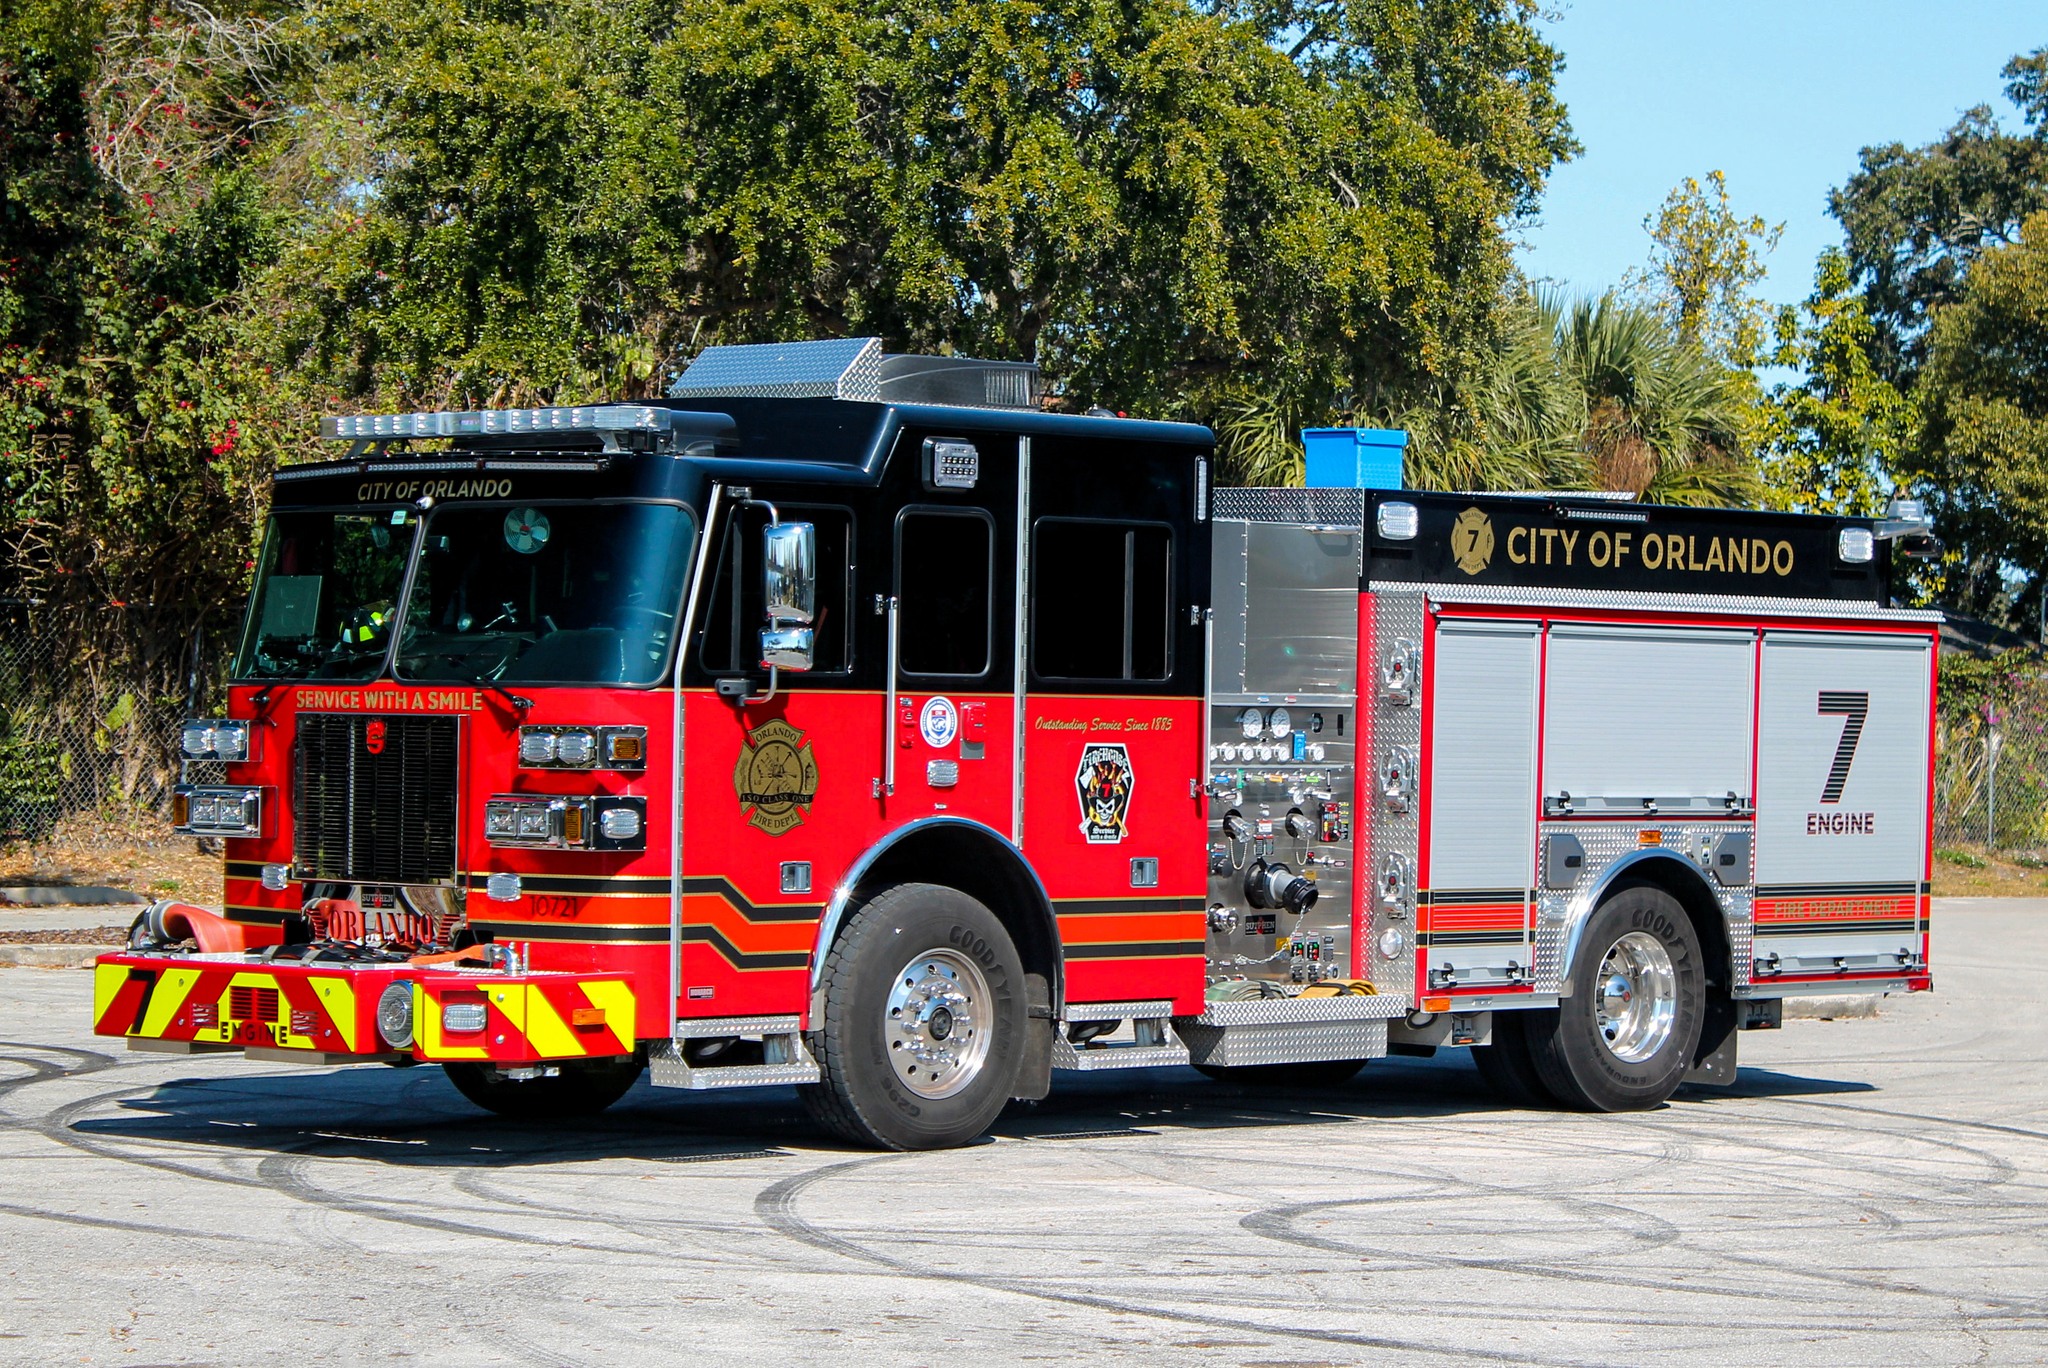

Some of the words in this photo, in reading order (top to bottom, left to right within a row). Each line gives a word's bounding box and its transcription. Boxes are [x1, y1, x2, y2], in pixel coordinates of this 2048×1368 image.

[358, 483, 393, 501] CITY
[395, 481, 420, 499] OF
[423, 478, 512, 498] ORLANDO
[1468, 530, 1479, 552] 7
[1507, 526, 1580, 565] CITY
[1588, 531, 1632, 568] OF
[1641, 533, 1794, 576] ORLANDO
[296, 690, 360, 709] SERVICE
[364, 691, 407, 710] WITH
[411, 692, 424, 710] A
[428, 692, 483, 711] SMILE
[755, 727, 797, 743] ORLANDO
[1035, 716, 1088, 734] Outstanding
[1090, 717, 1122, 731] Service
[1124, 718, 1149, 732] Since
[1151, 717, 1173, 731] 1885
[1818, 690, 1869, 804] 7
[762, 793, 789, 803] CLASS
[1102, 783, 1111, 798] 7
[755, 812, 772, 828] FIRE
[1806, 812, 1875, 835] ENGINE
[529, 896, 577, 917] 10721
[1774, 902, 1805, 918] FIRE
[1809, 900, 1899, 917] DEPARTMENT
[328, 909, 434, 945] ORLANDO
[128, 967, 157, 1035] 7
[220, 1021, 288, 1044] ENGINE
